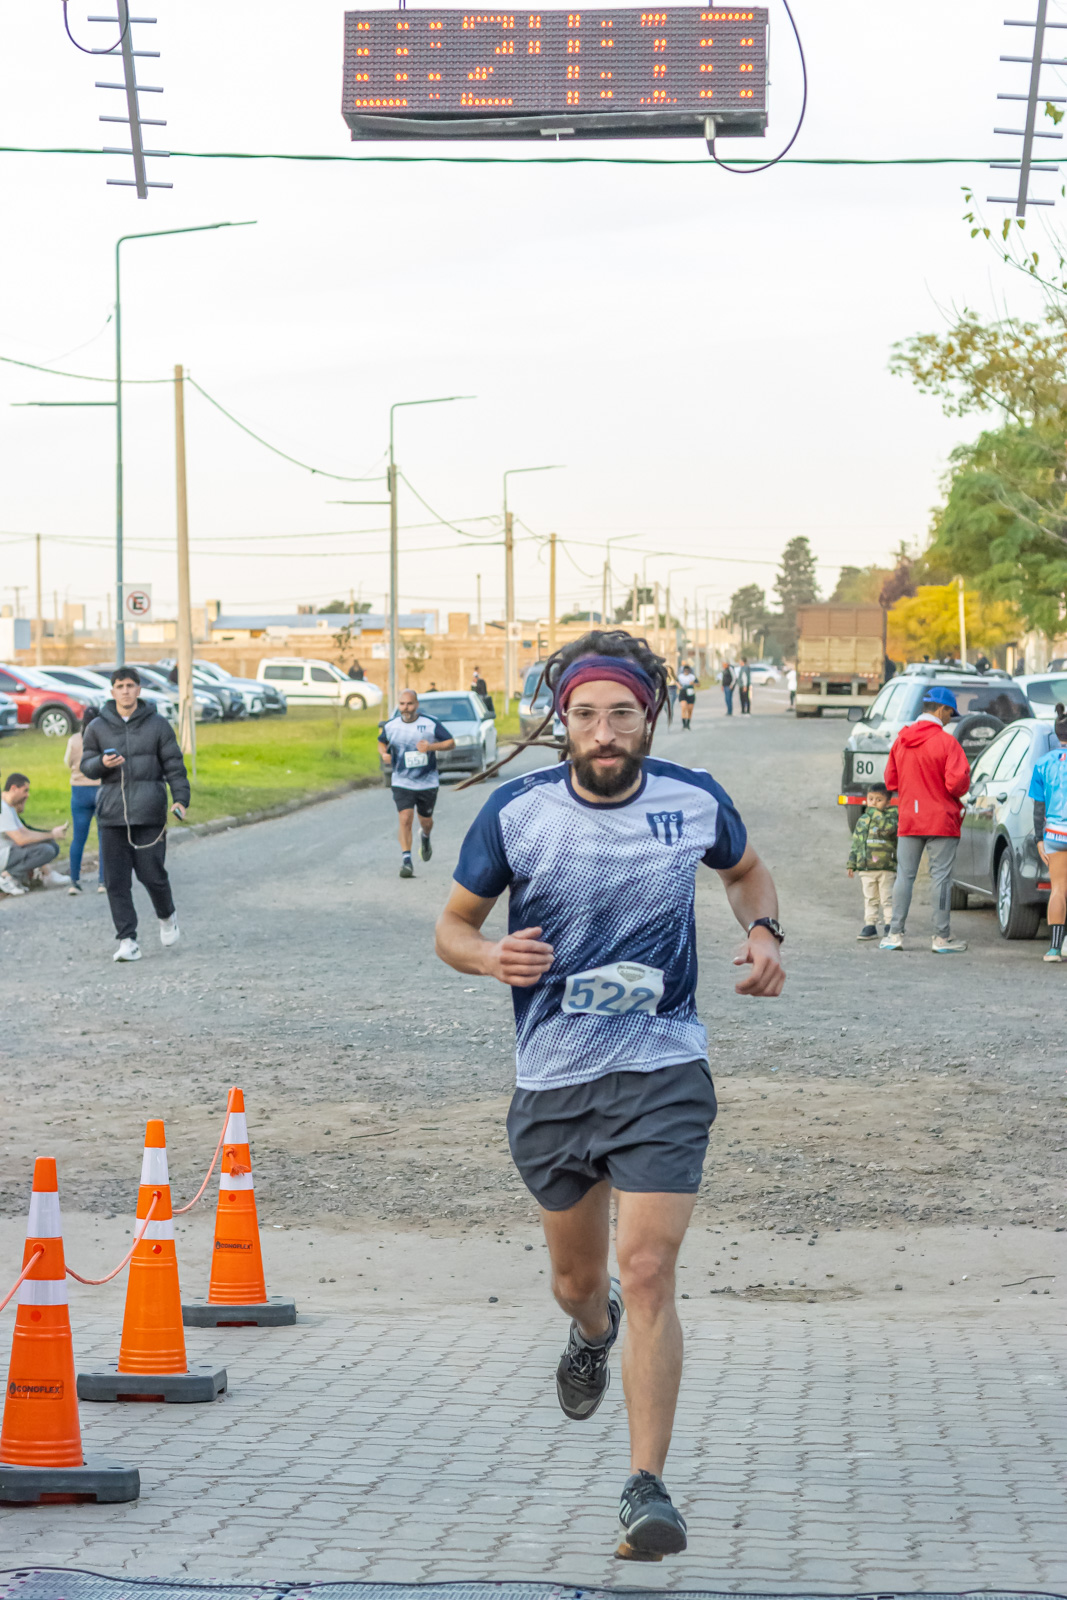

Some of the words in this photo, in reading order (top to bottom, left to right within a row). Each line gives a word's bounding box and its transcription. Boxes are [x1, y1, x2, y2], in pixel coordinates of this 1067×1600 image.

[133, 597, 144, 610] E
[856, 760, 873, 774] 80
[653, 814, 678, 822] SFC
[568, 978, 655, 1013] 522
[16, 1385, 60, 1394] CONOFLEX
